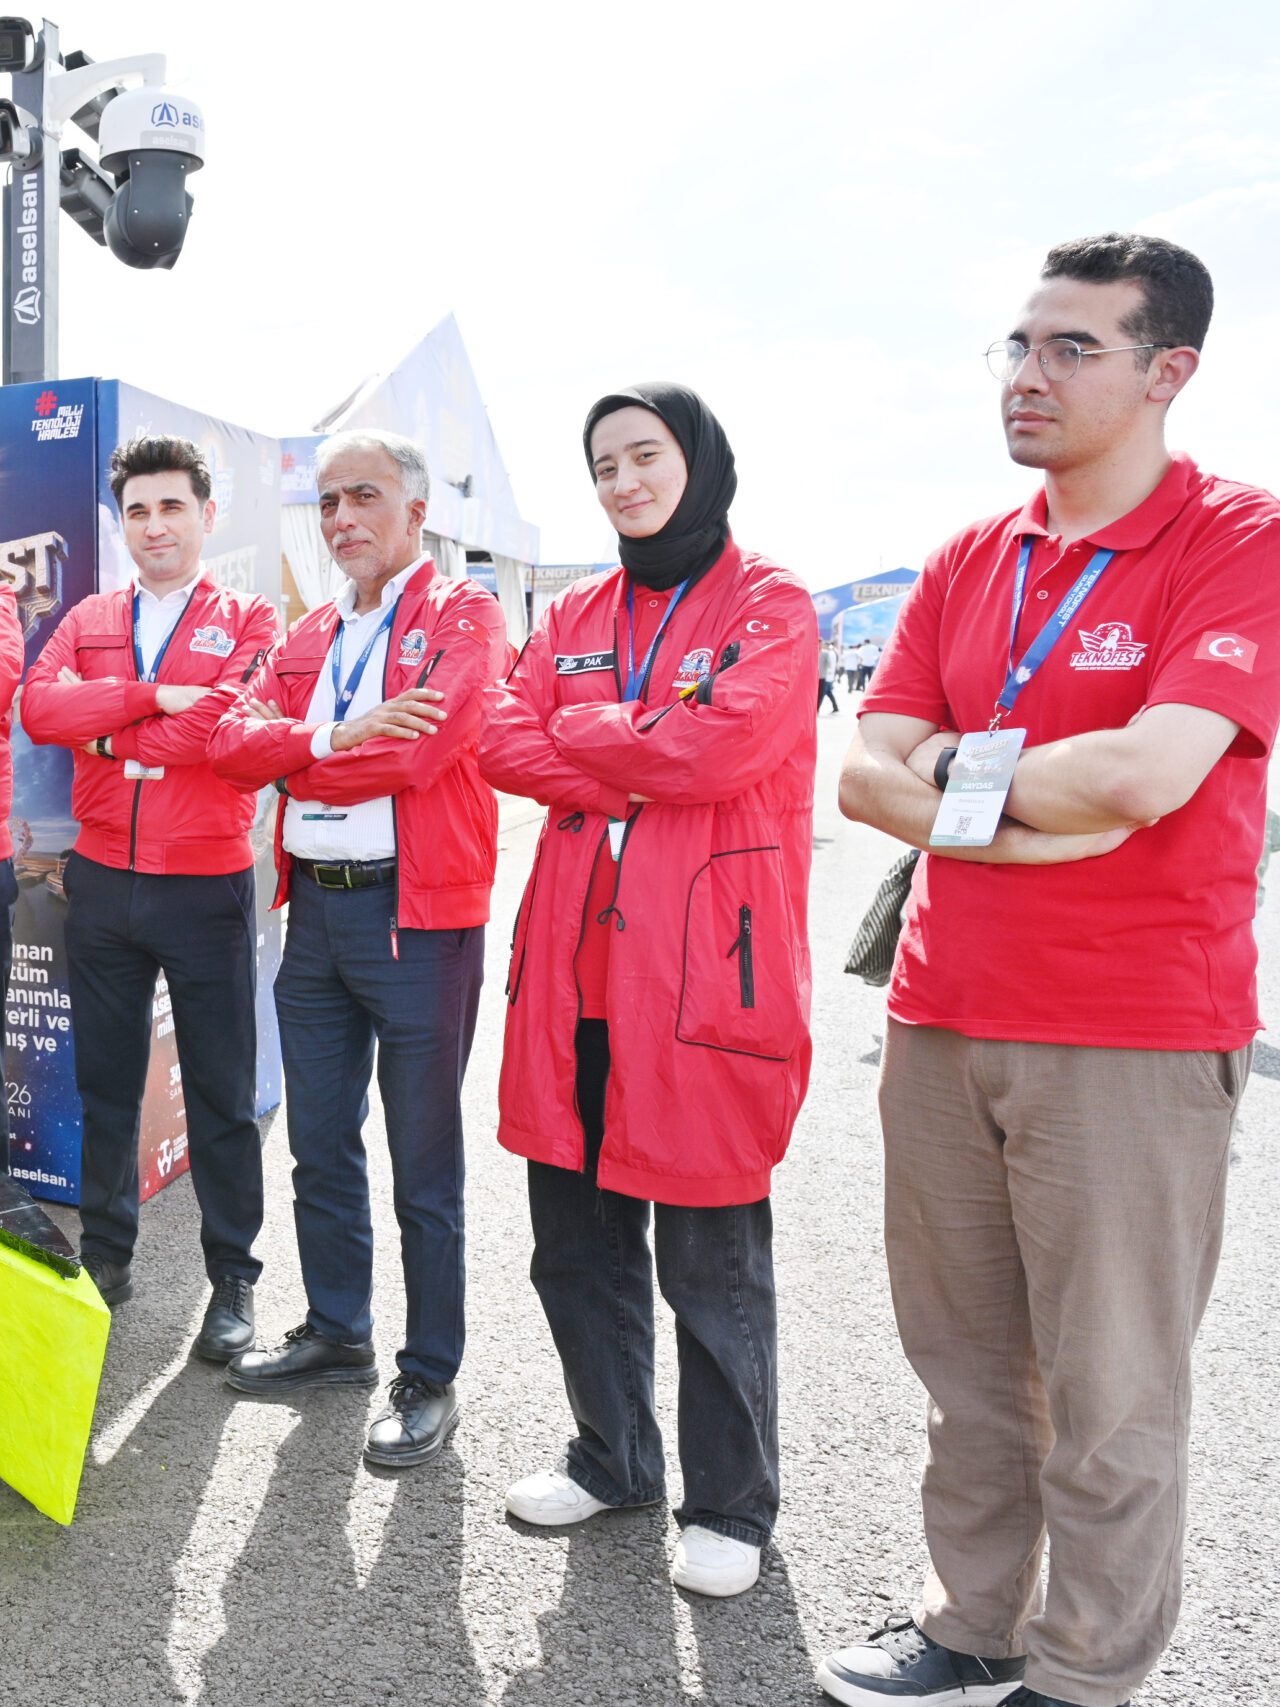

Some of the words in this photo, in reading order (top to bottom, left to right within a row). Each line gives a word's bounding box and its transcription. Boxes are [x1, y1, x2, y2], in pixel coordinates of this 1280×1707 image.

[17, 173, 38, 283] aselsan
[1059, 569, 1101, 627] TEKNOFEST
[583, 656, 603, 668] PAK
[1070, 651, 1146, 667] TEKNOFEST
[10, 962, 48, 984] tüm
[6, 1008, 40, 1028] erli
[46, 1015, 70, 1032] ve
[33, 1035, 57, 1053] ve
[8, 1106, 31, 1119] ANI
[13, 1167, 67, 1187] aselsan
